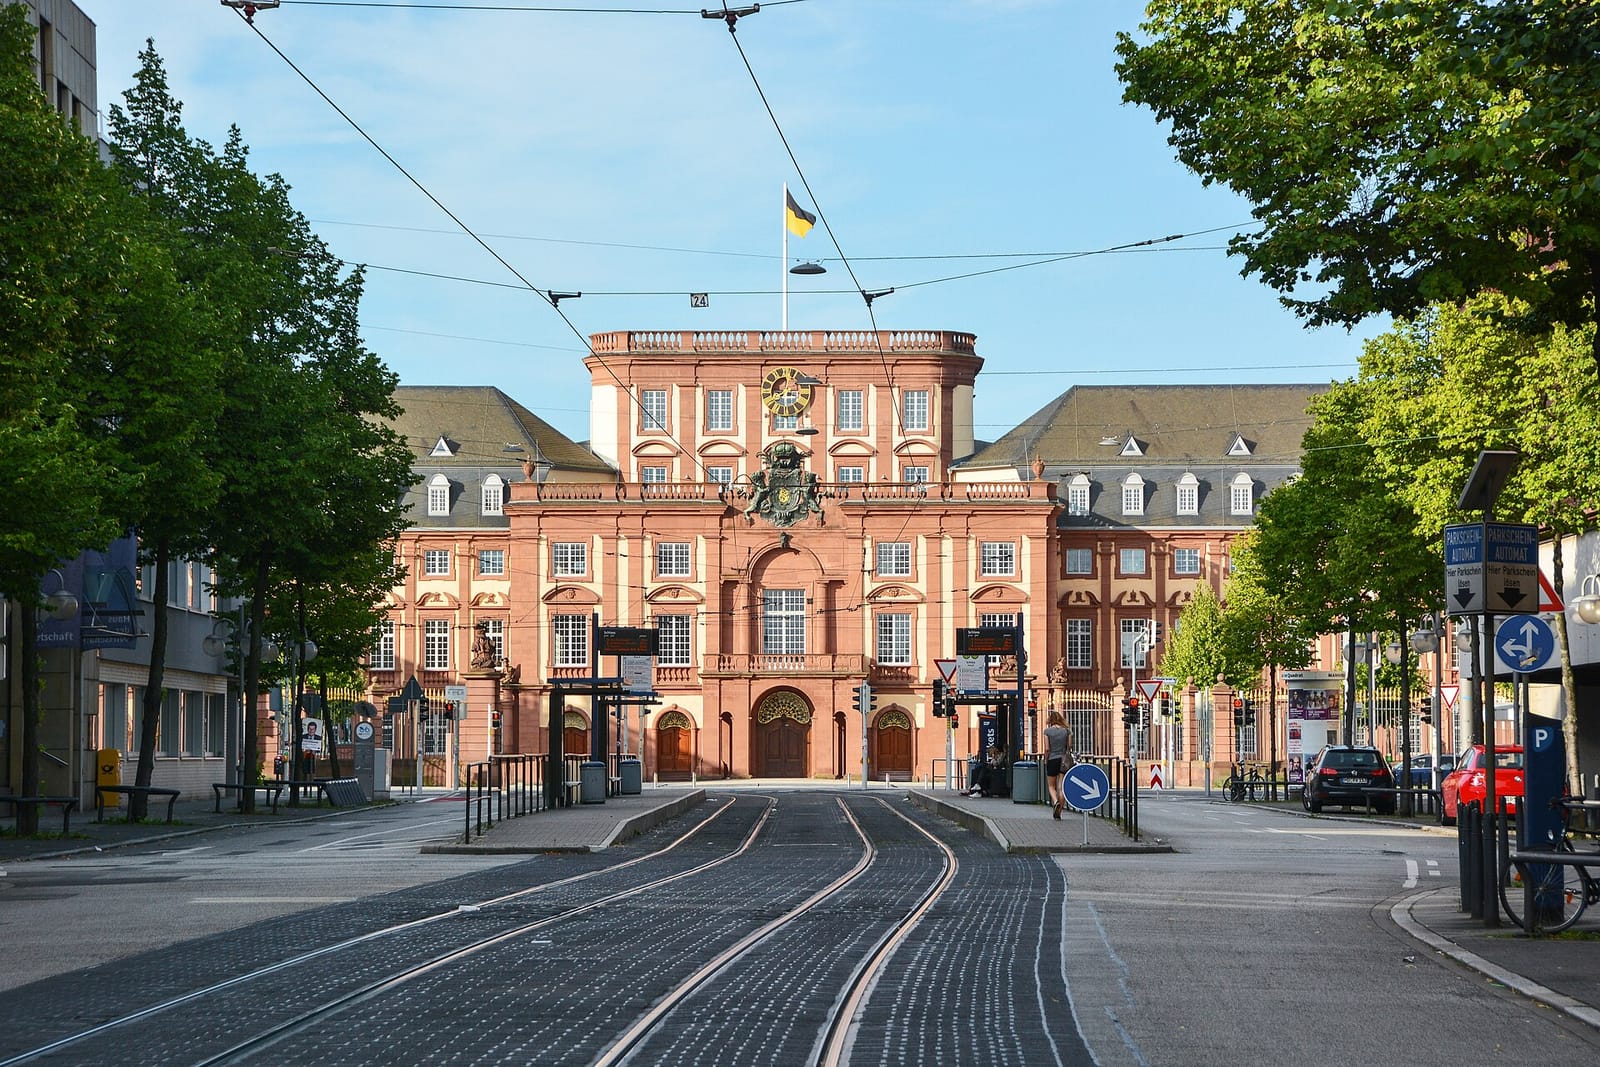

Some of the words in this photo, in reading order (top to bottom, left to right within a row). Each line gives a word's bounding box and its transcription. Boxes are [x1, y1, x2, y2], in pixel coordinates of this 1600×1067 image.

[693, 295, 707, 306] 24
[1447, 529, 1482, 545] PARKSCHEIN-
[1488, 528, 1536, 545] PARKSCHEIN-
[1452, 546, 1477, 561] AUTOMAT
[1495, 546, 1529, 561] AUTOMAT
[1457, 567, 1481, 577] Parkschein
[1488, 567, 1502, 575] Hier
[1502, 567, 1536, 577] Parkschein
[1503, 577, 1520, 587] lösen
[36, 631, 73, 641] rtschaft
[985, 728, 995, 762] Tkets
[1535, 729, 1548, 748] P
